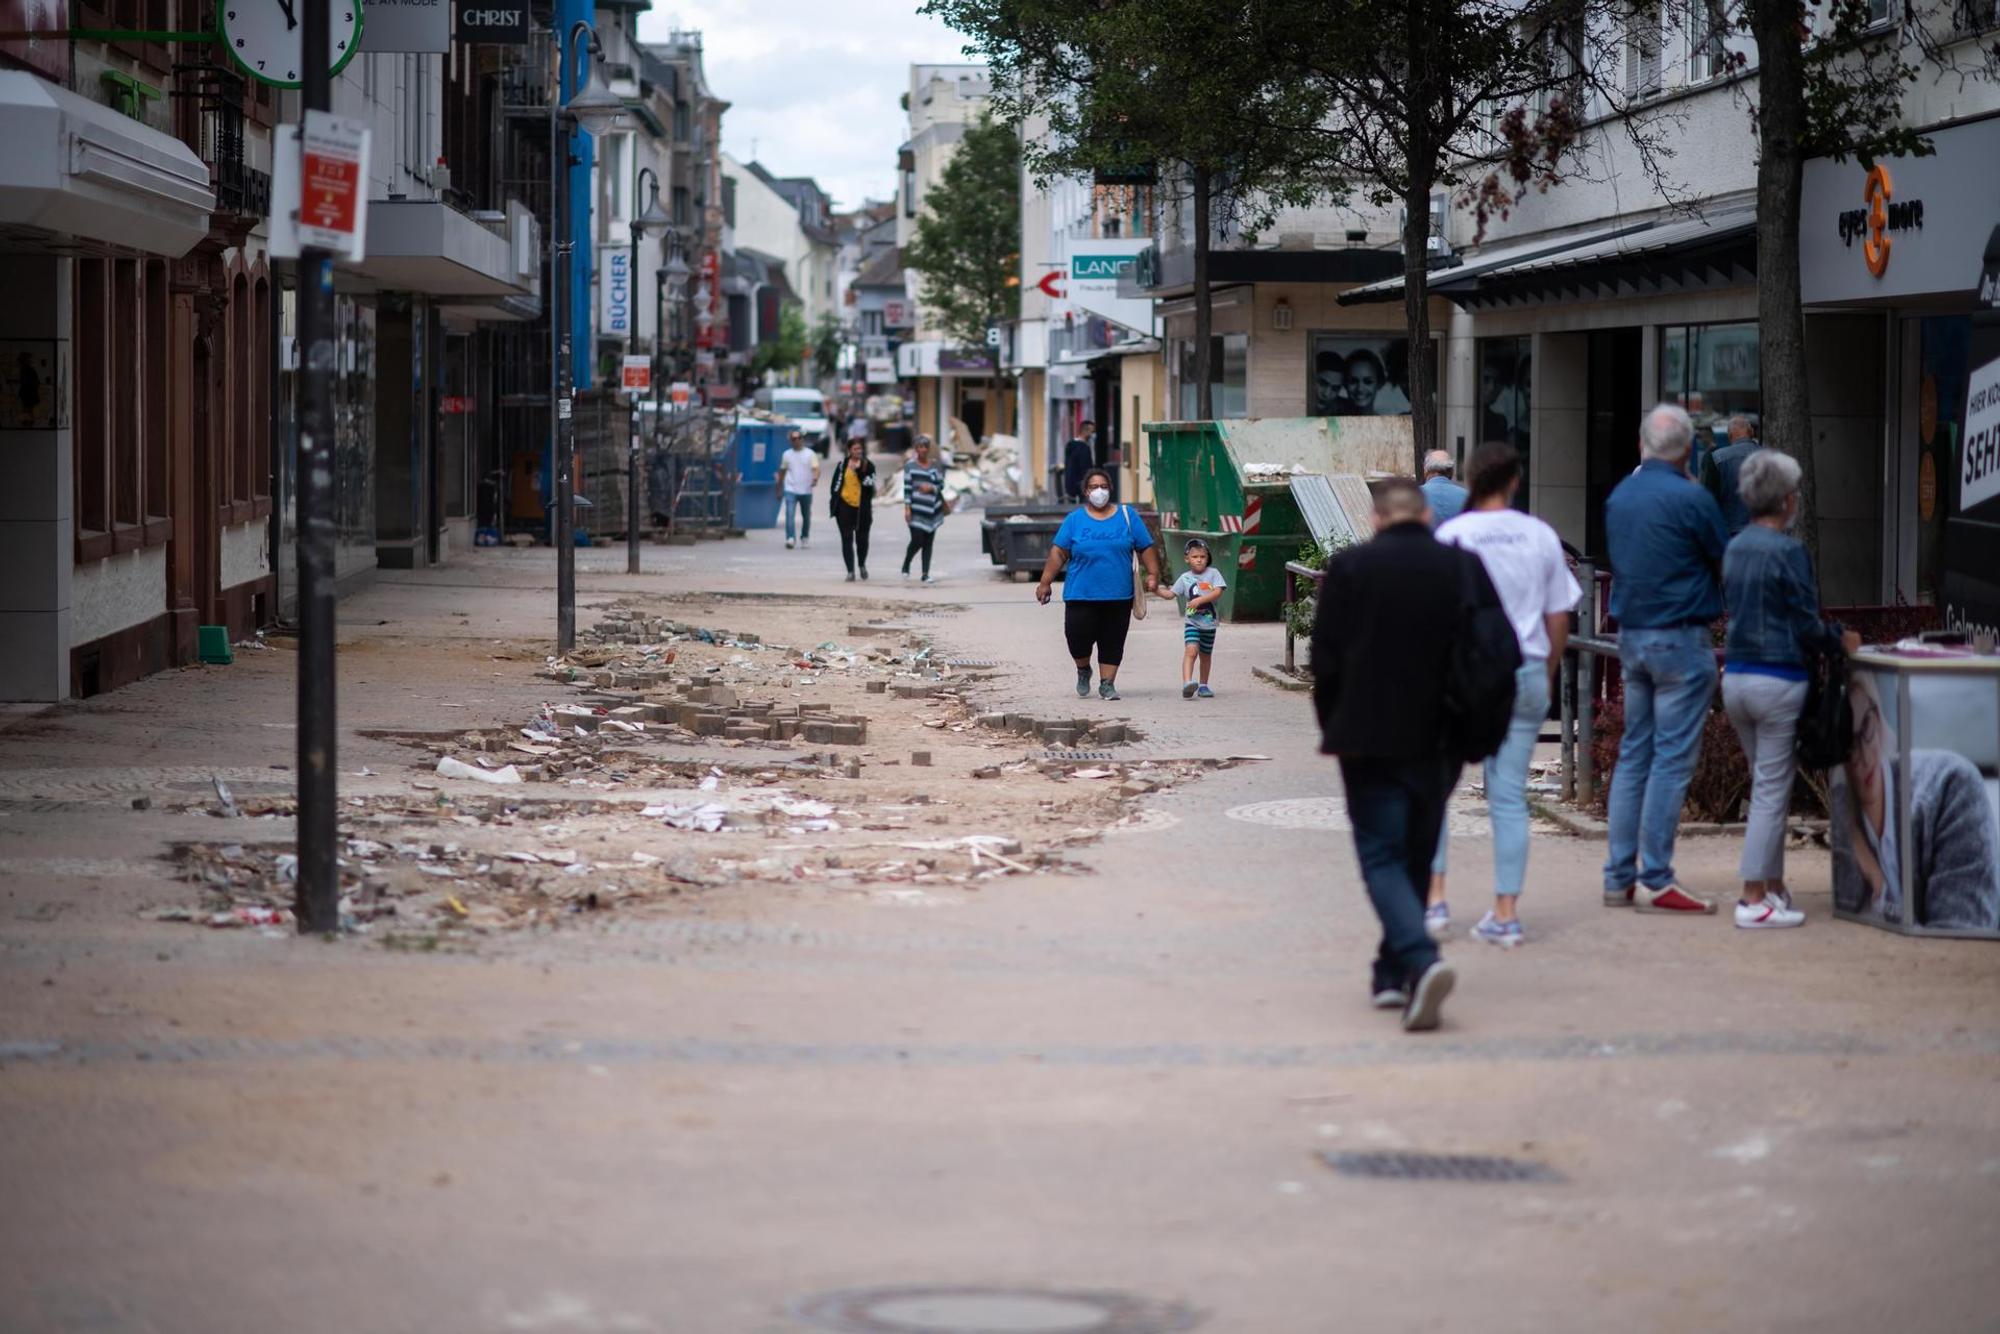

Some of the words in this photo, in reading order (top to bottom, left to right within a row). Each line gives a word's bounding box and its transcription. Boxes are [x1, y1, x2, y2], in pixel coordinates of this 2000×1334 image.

[228, 11, 236, 21] 9
[344, 12, 353, 22] 3
[463, 9, 522, 26] CHRIST
[236, 39, 244, 48] 8
[337, 40, 345, 50] 4
[257, 61, 265, 70] 7
[287, 71, 295, 80] 6
[608, 255, 626, 329] BÜCHER
